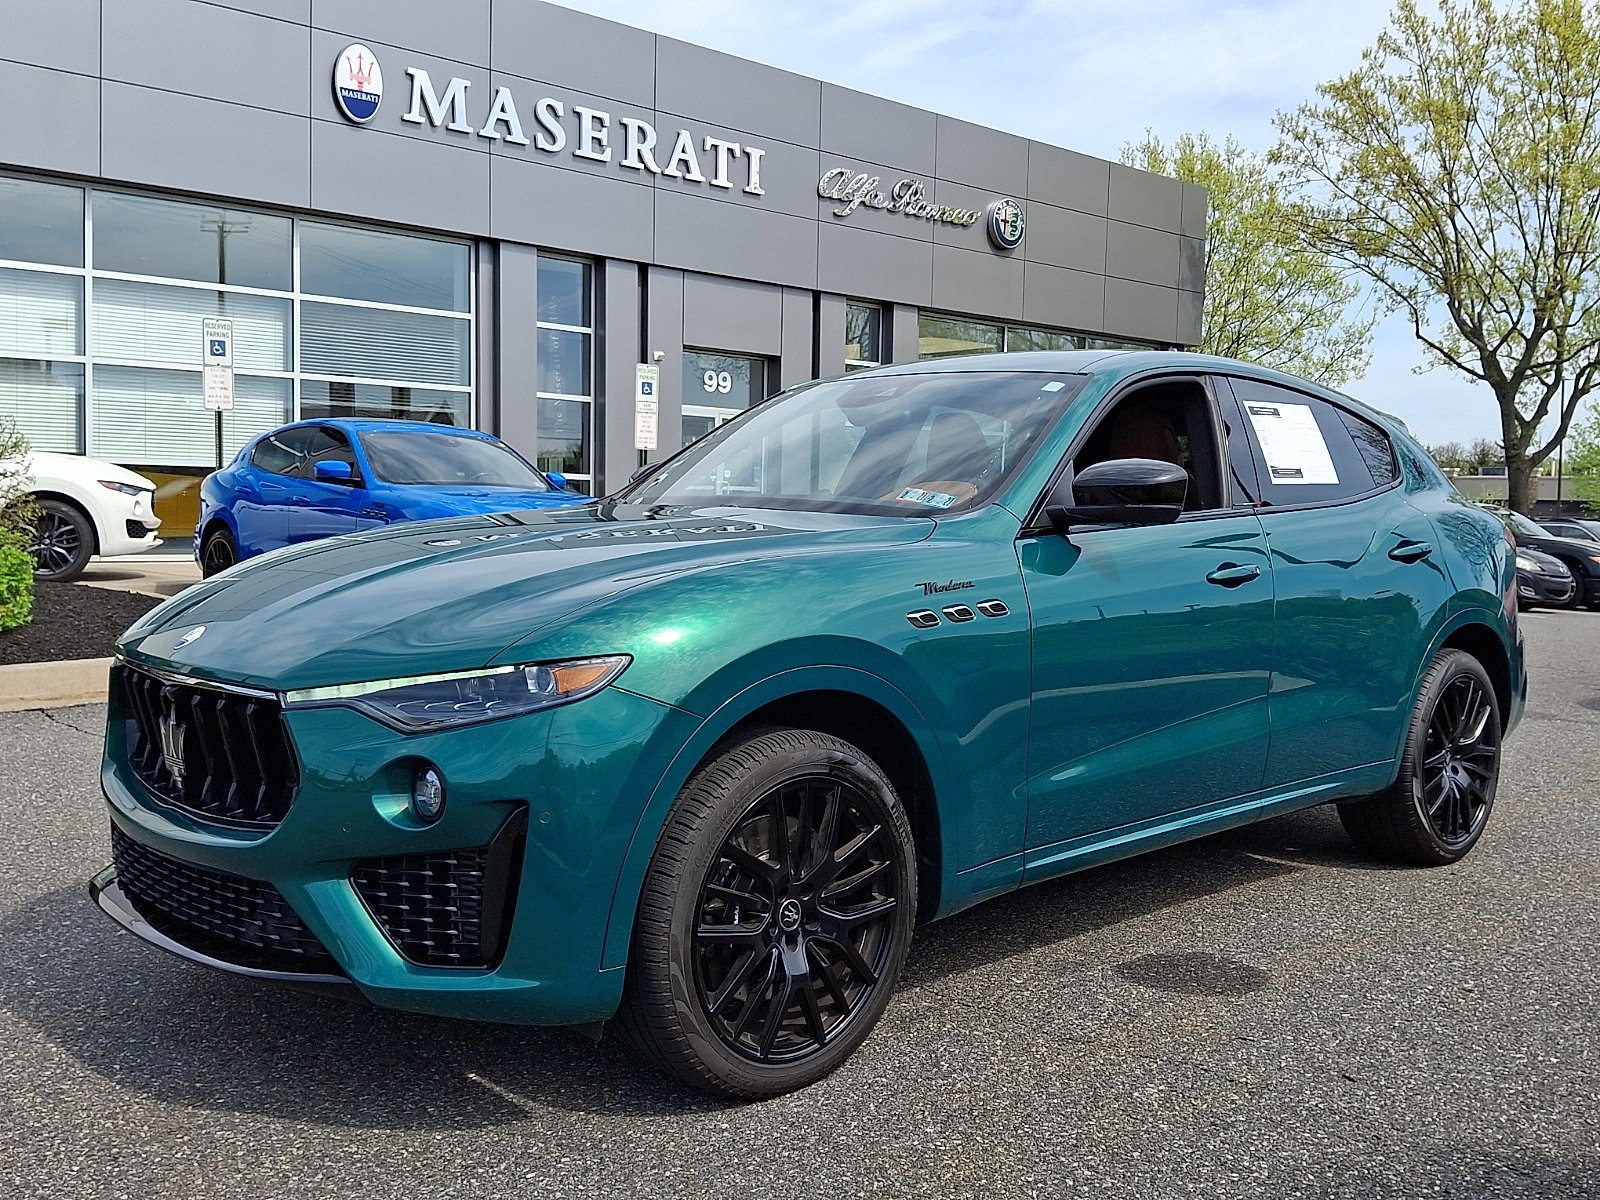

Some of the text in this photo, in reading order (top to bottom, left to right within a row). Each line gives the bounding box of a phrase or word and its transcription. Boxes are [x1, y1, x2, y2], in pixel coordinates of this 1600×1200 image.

[341, 88, 379, 103] MASERATI
[402, 66, 766, 195] MASERATI
[817, 167, 888, 218] Alfa
[887, 179, 982, 227] Romeo
[205, 322, 230, 330] RESERVED
[206, 330, 229, 338] PARKING
[703, 370, 732, 394] 99
[914, 578, 976, 596] Modena
